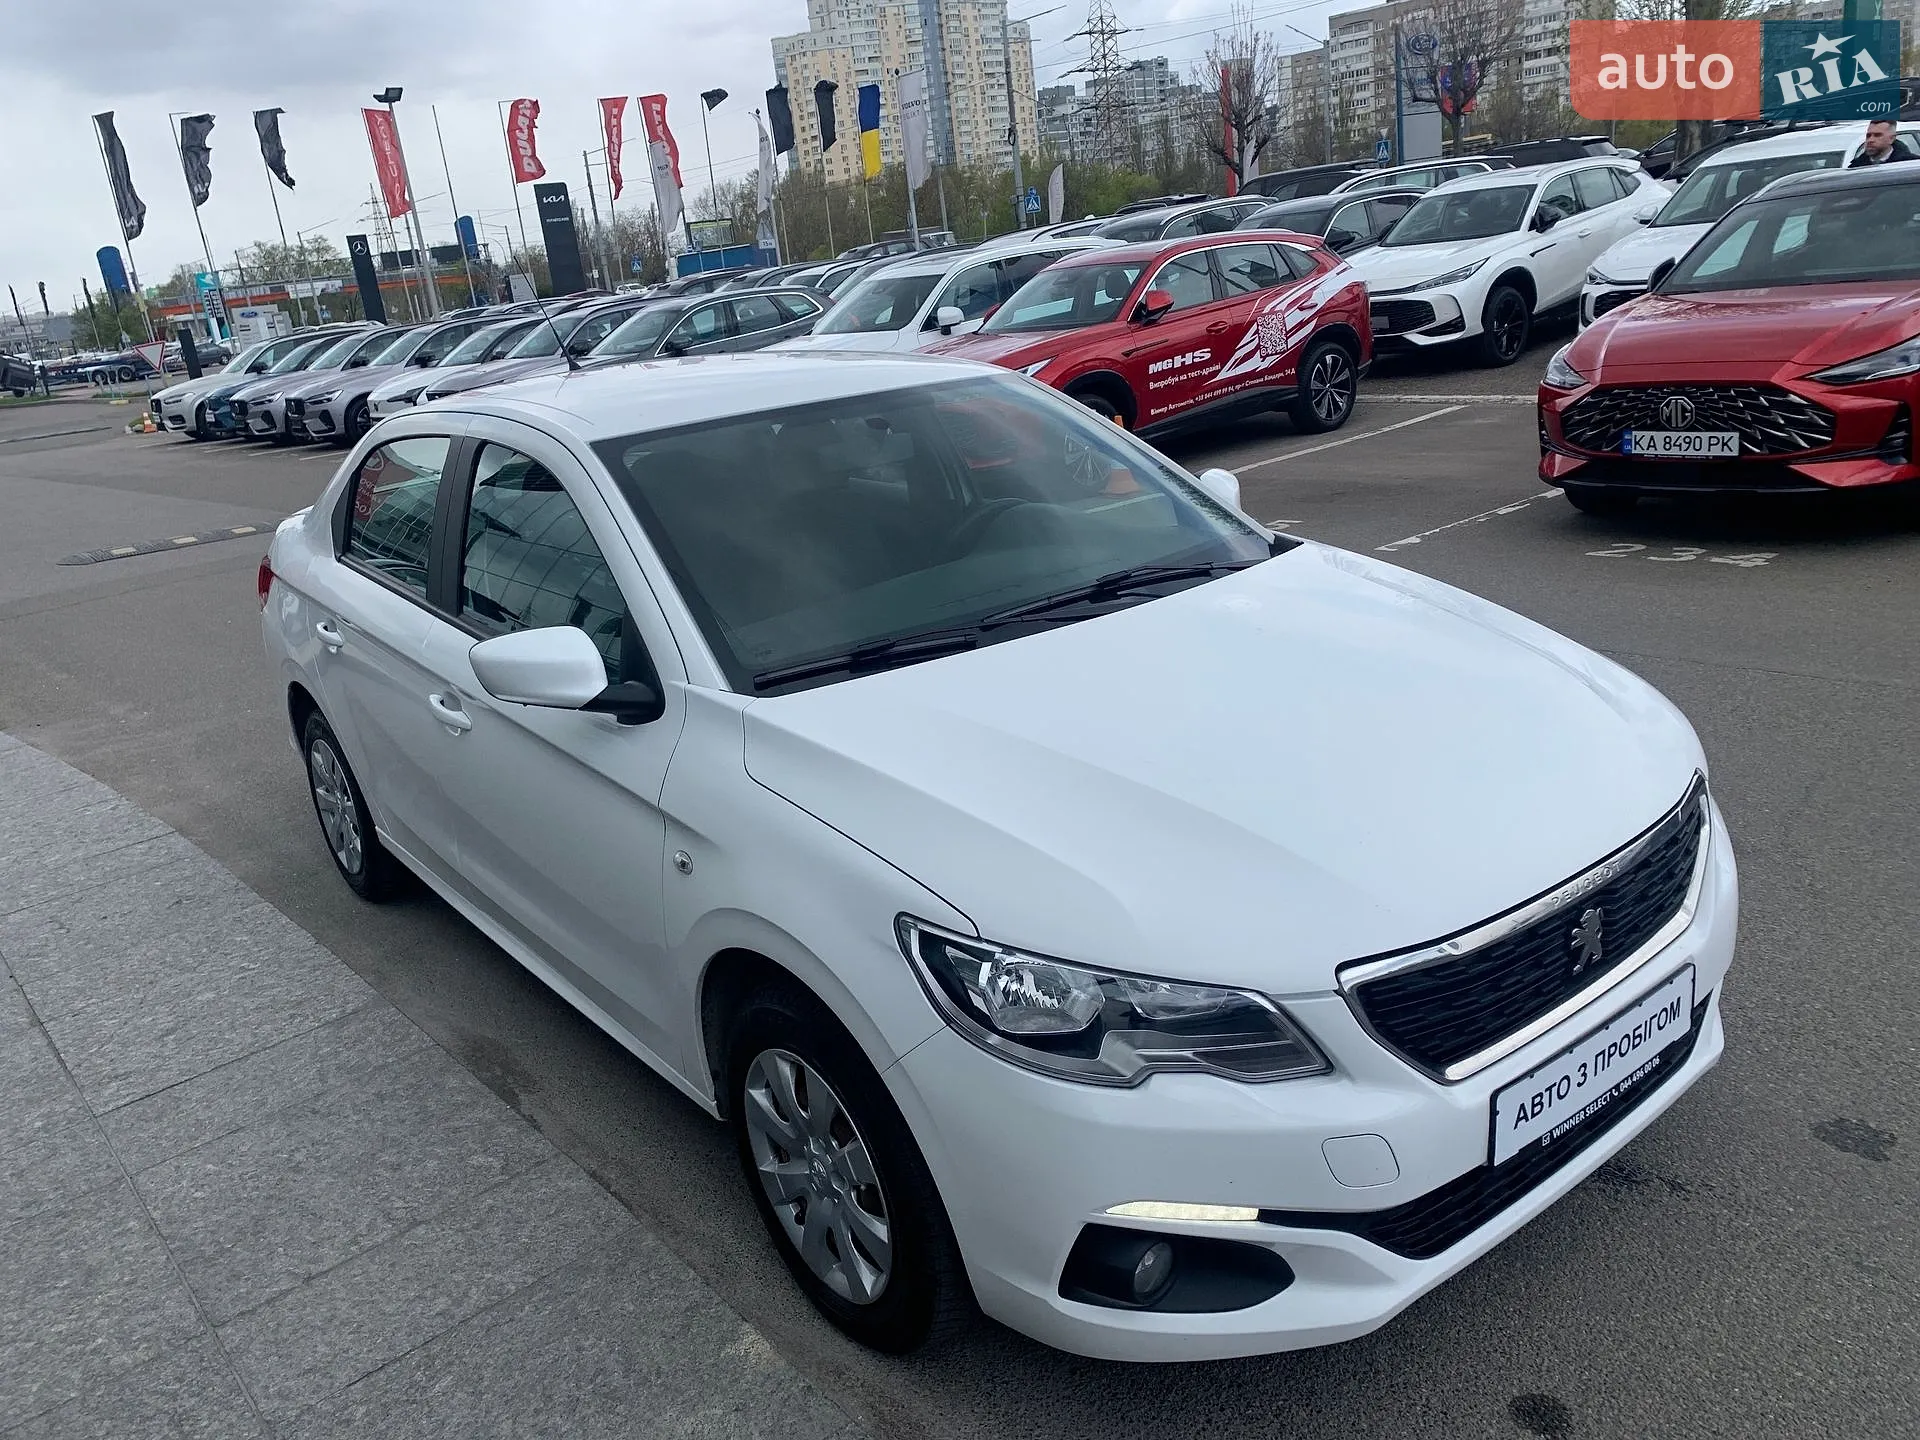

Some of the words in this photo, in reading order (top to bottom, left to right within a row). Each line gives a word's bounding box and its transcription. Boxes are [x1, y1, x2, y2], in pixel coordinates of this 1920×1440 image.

[1149, 373, 1179, 390] Випробуй
[1180, 373, 1187, 381] на
[1663, 399, 1692, 427] MG
[1633, 435, 1657, 451] KA
[1663, 435, 1703, 451] 8490
[1707, 435, 1734, 452] PK
[1551, 860, 1621, 907] PEUGEOT
[1513, 1074, 1571, 1130] АВТО
[1593, 996, 1681, 1077] ПРОБІГОМ
[1552, 1110, 1585, 1139] WINNER
[1585, 1091, 1611, 1117] SELECT
